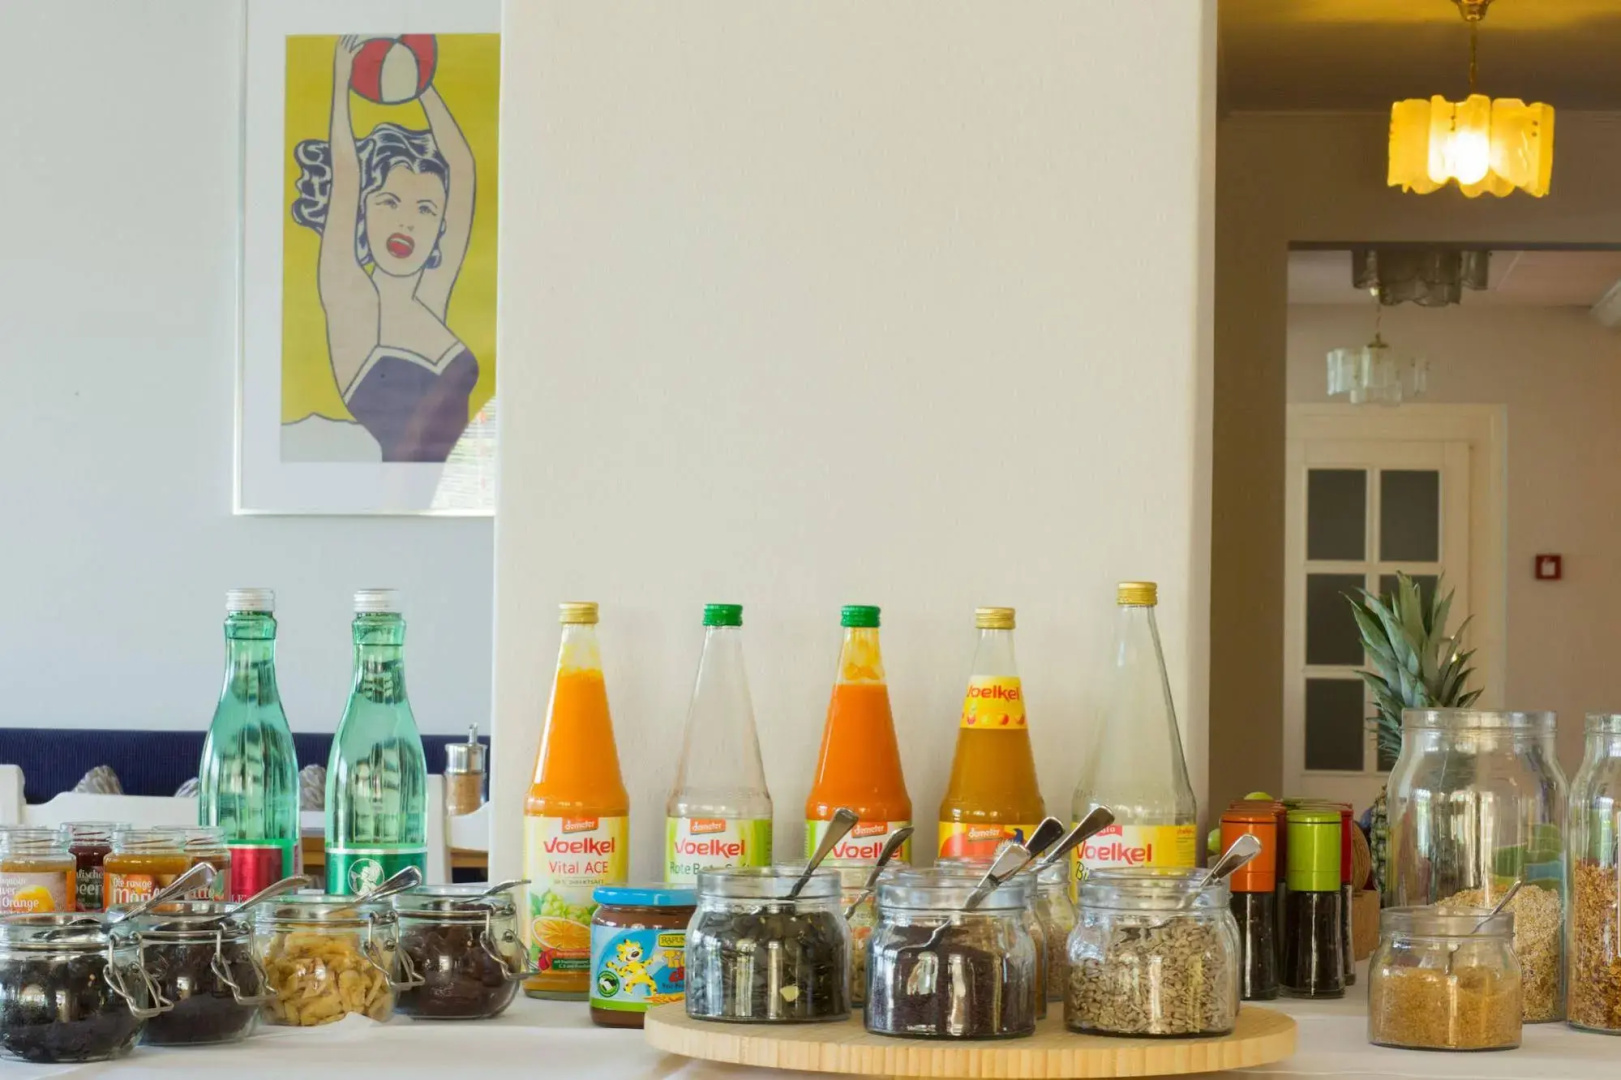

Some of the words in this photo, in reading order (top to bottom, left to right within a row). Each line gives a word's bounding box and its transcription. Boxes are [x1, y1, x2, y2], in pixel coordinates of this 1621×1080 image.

[543, 836, 615, 857] Voelkel
[674, 838, 746, 859] Voelkel
[832, 841, 904, 859] Voelel
[1076, 838, 1152, 865] Voelkel
[549, 860, 579, 874] Vital
[584, 860, 609, 875] ACE
[2, 895, 40, 913] Orange
